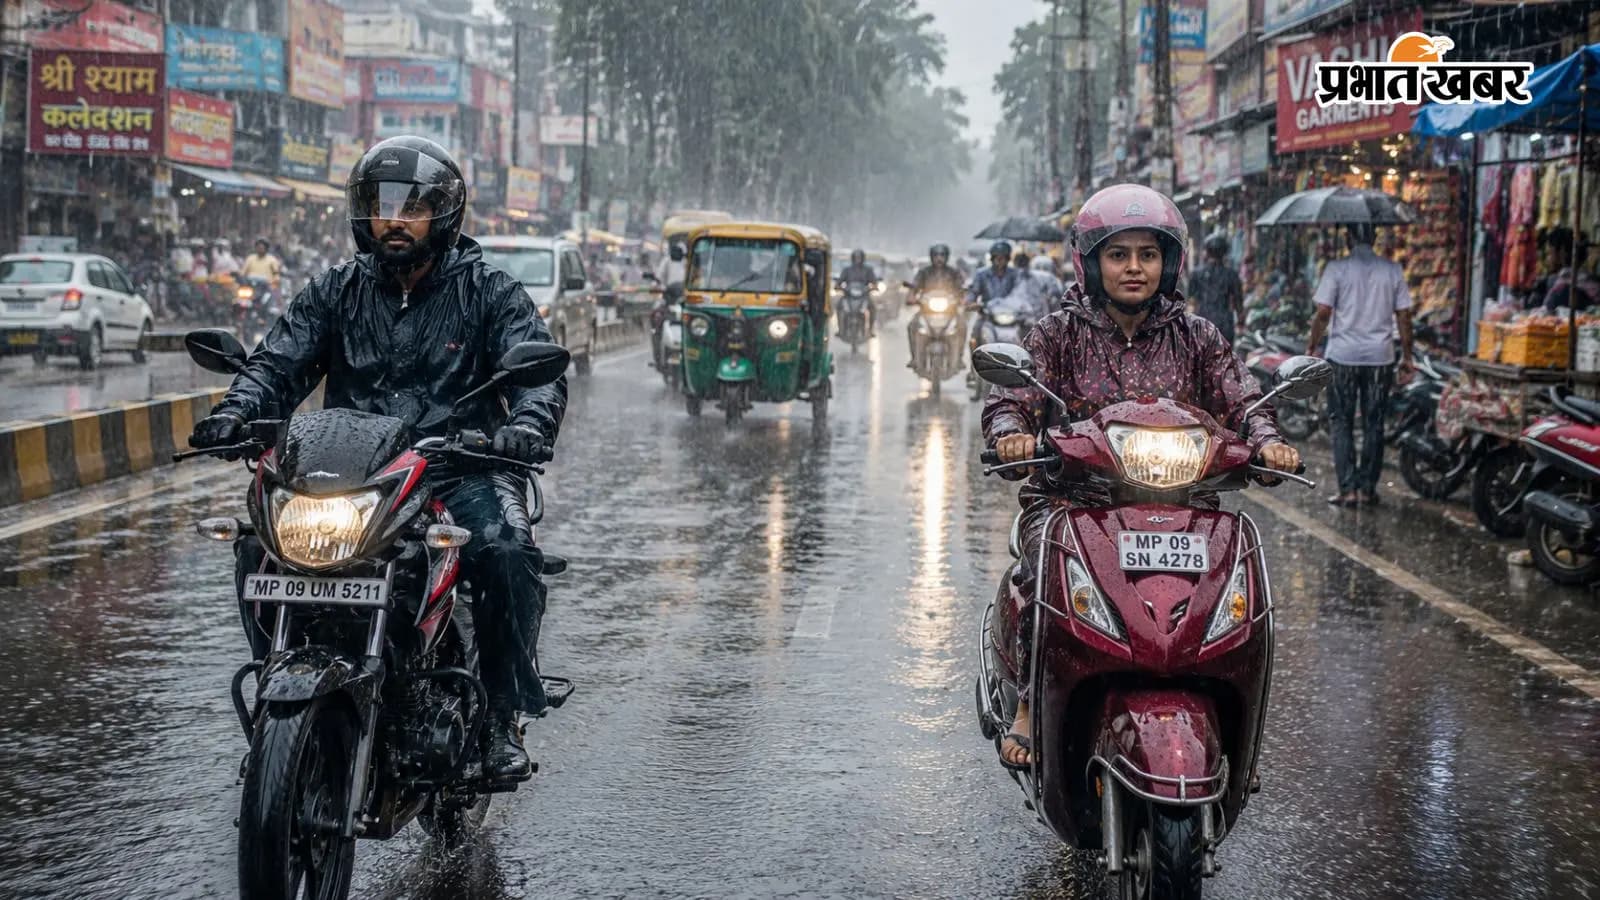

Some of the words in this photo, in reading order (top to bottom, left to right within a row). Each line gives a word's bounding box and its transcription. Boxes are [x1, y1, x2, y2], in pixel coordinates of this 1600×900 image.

[41, 54, 76, 92] श्री
[84, 65, 157, 95] श्याम
[1136, 535, 1162, 550] MP
[1169, 536, 1190, 550] 09
[1126, 552, 1151, 567] SN
[1158, 553, 1204, 569] 4278
[254, 579, 280, 596] MP
[285, 580, 305, 597] 09
[310, 582, 337, 598] UM
[341, 583, 381, 600] 5211
